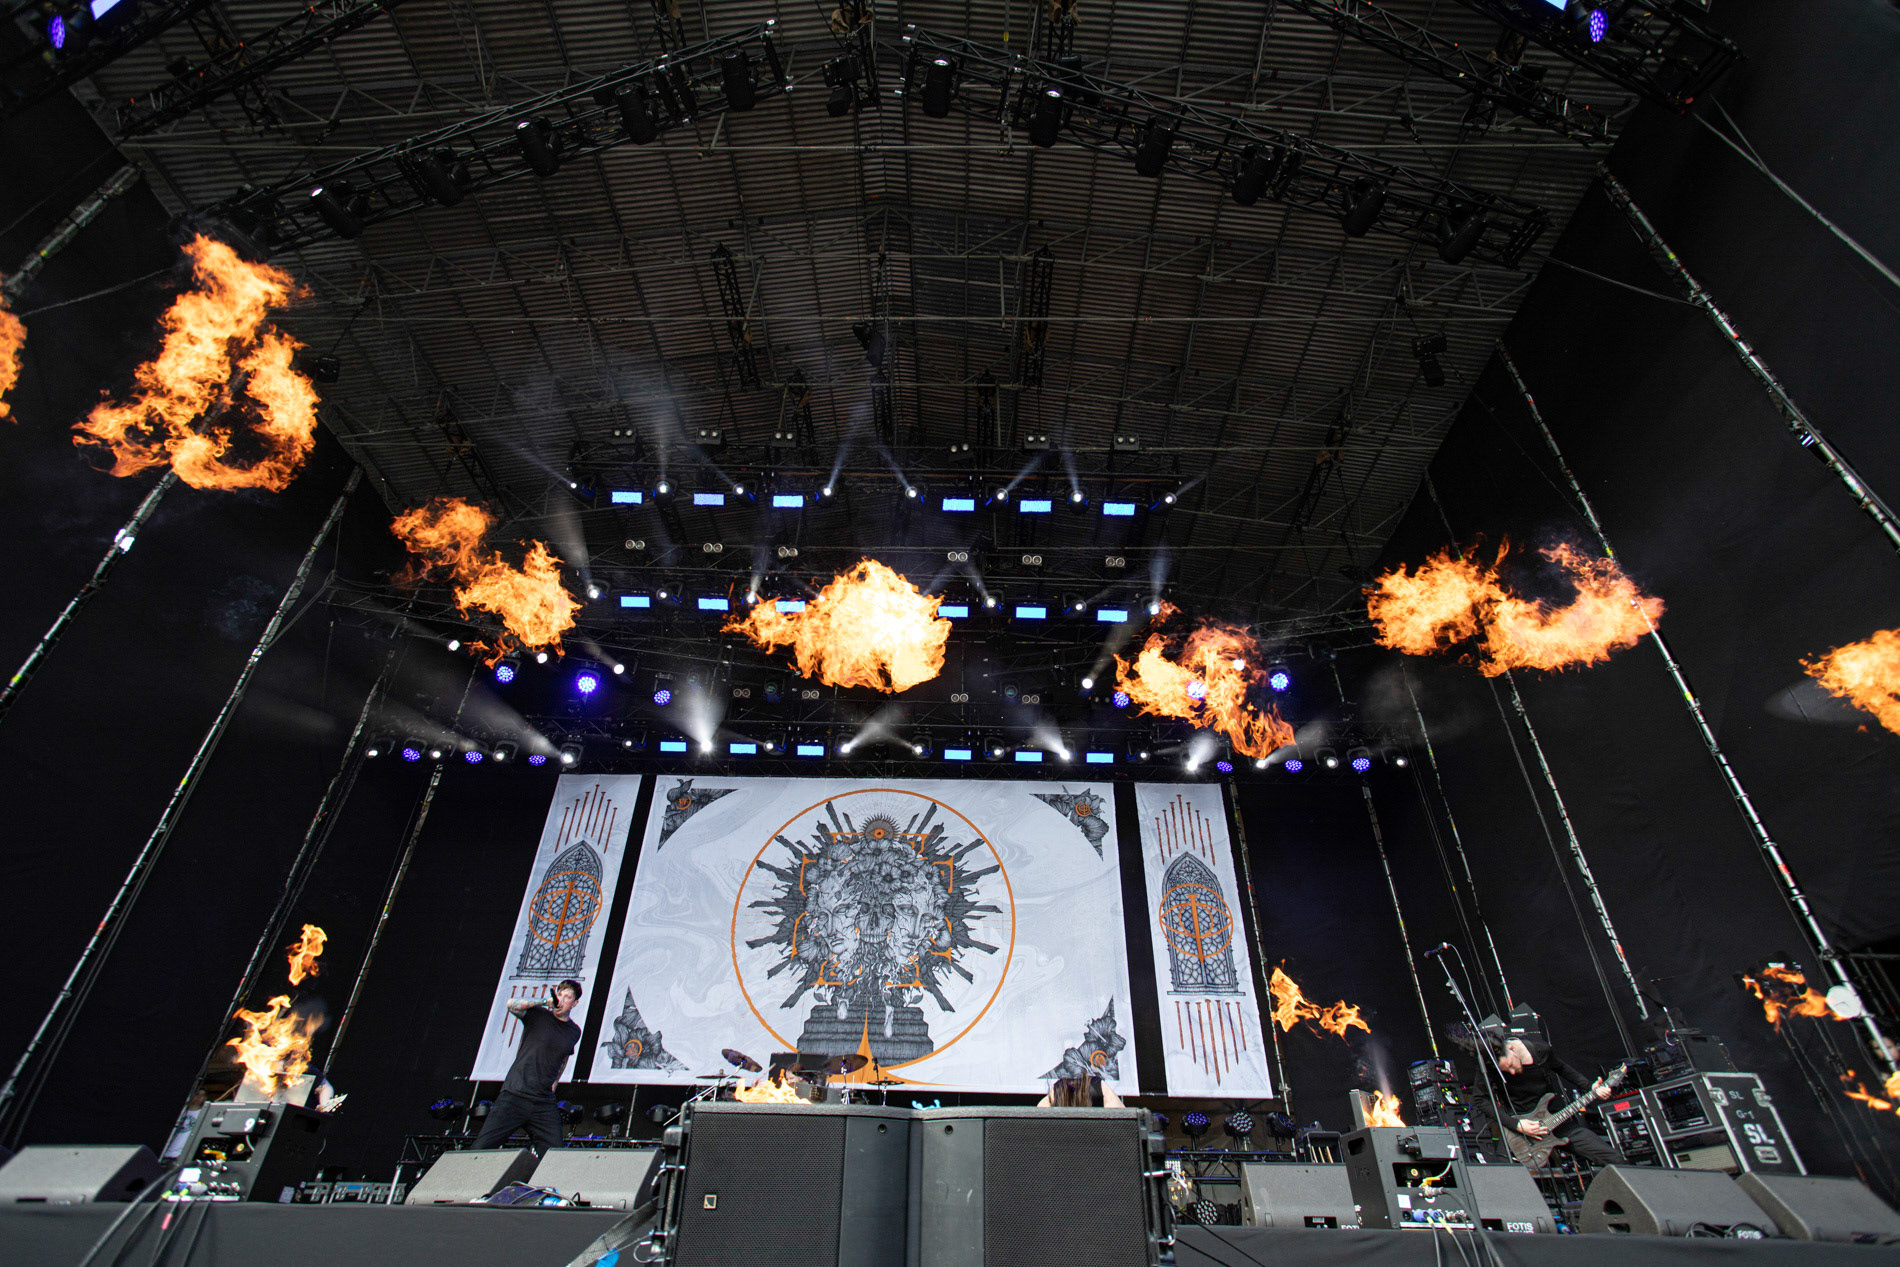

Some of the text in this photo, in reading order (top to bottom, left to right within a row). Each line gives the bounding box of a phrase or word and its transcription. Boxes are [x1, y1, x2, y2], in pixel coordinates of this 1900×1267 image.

[1729, 1091, 1744, 1100] SL
[1743, 1123, 1775, 1144] SL
[1507, 1222, 1534, 1231] FOTIS
[1737, 1230, 1762, 1239] FOTIS
